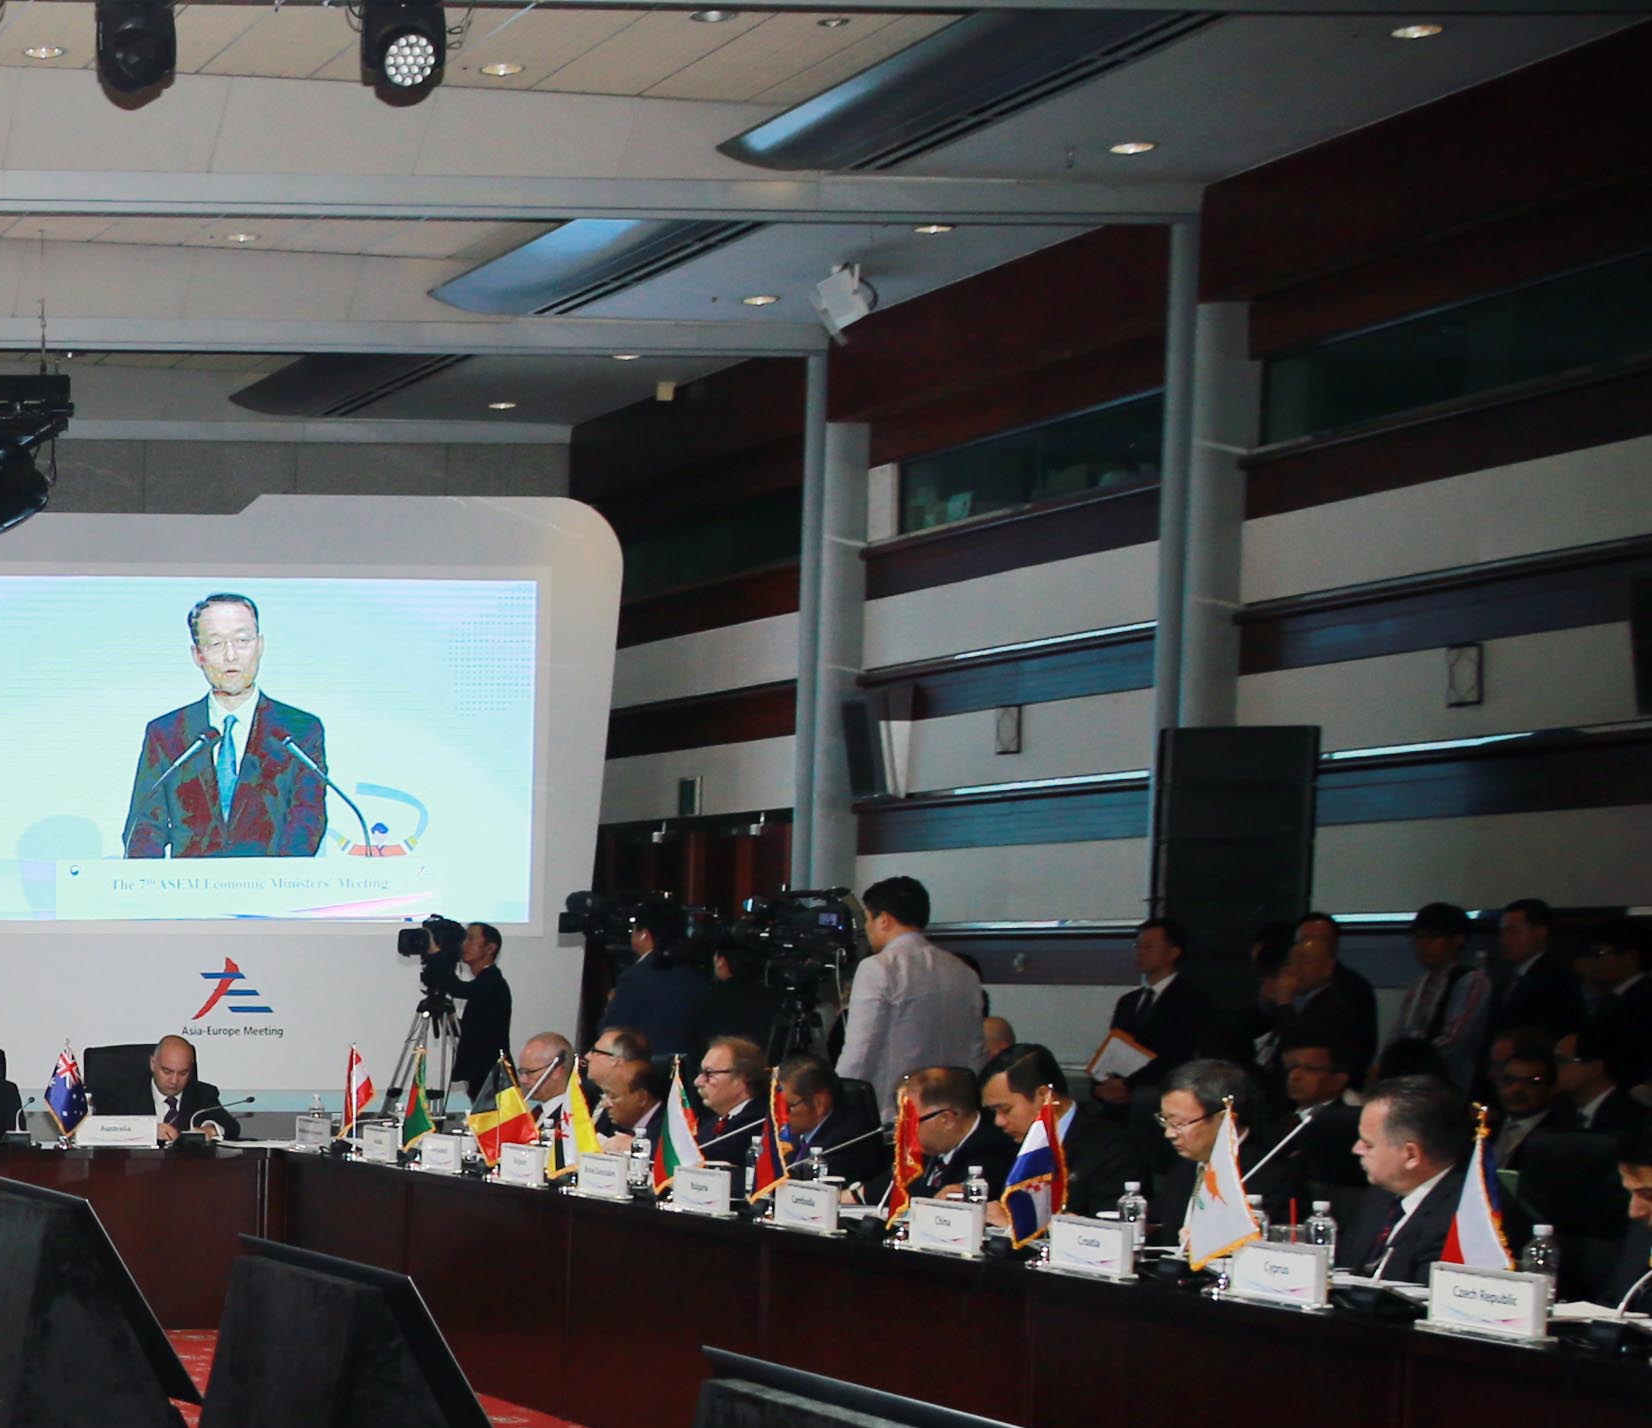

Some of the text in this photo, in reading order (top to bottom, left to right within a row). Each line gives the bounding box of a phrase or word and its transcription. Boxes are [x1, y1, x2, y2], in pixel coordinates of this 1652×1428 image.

[112, 878, 134, 891] The
[337, 878, 390, 892] Meeting
[181, 1026, 284, 1038] Asia-Europe Meeting
[791, 1194, 816, 1207] Cambodia
[935, 1215, 952, 1228] China
[1077, 1234, 1101, 1249] Croatia
[1263, 1259, 1291, 1277] Cyprus
[1452, 1284, 1519, 1307] Czech Republic
